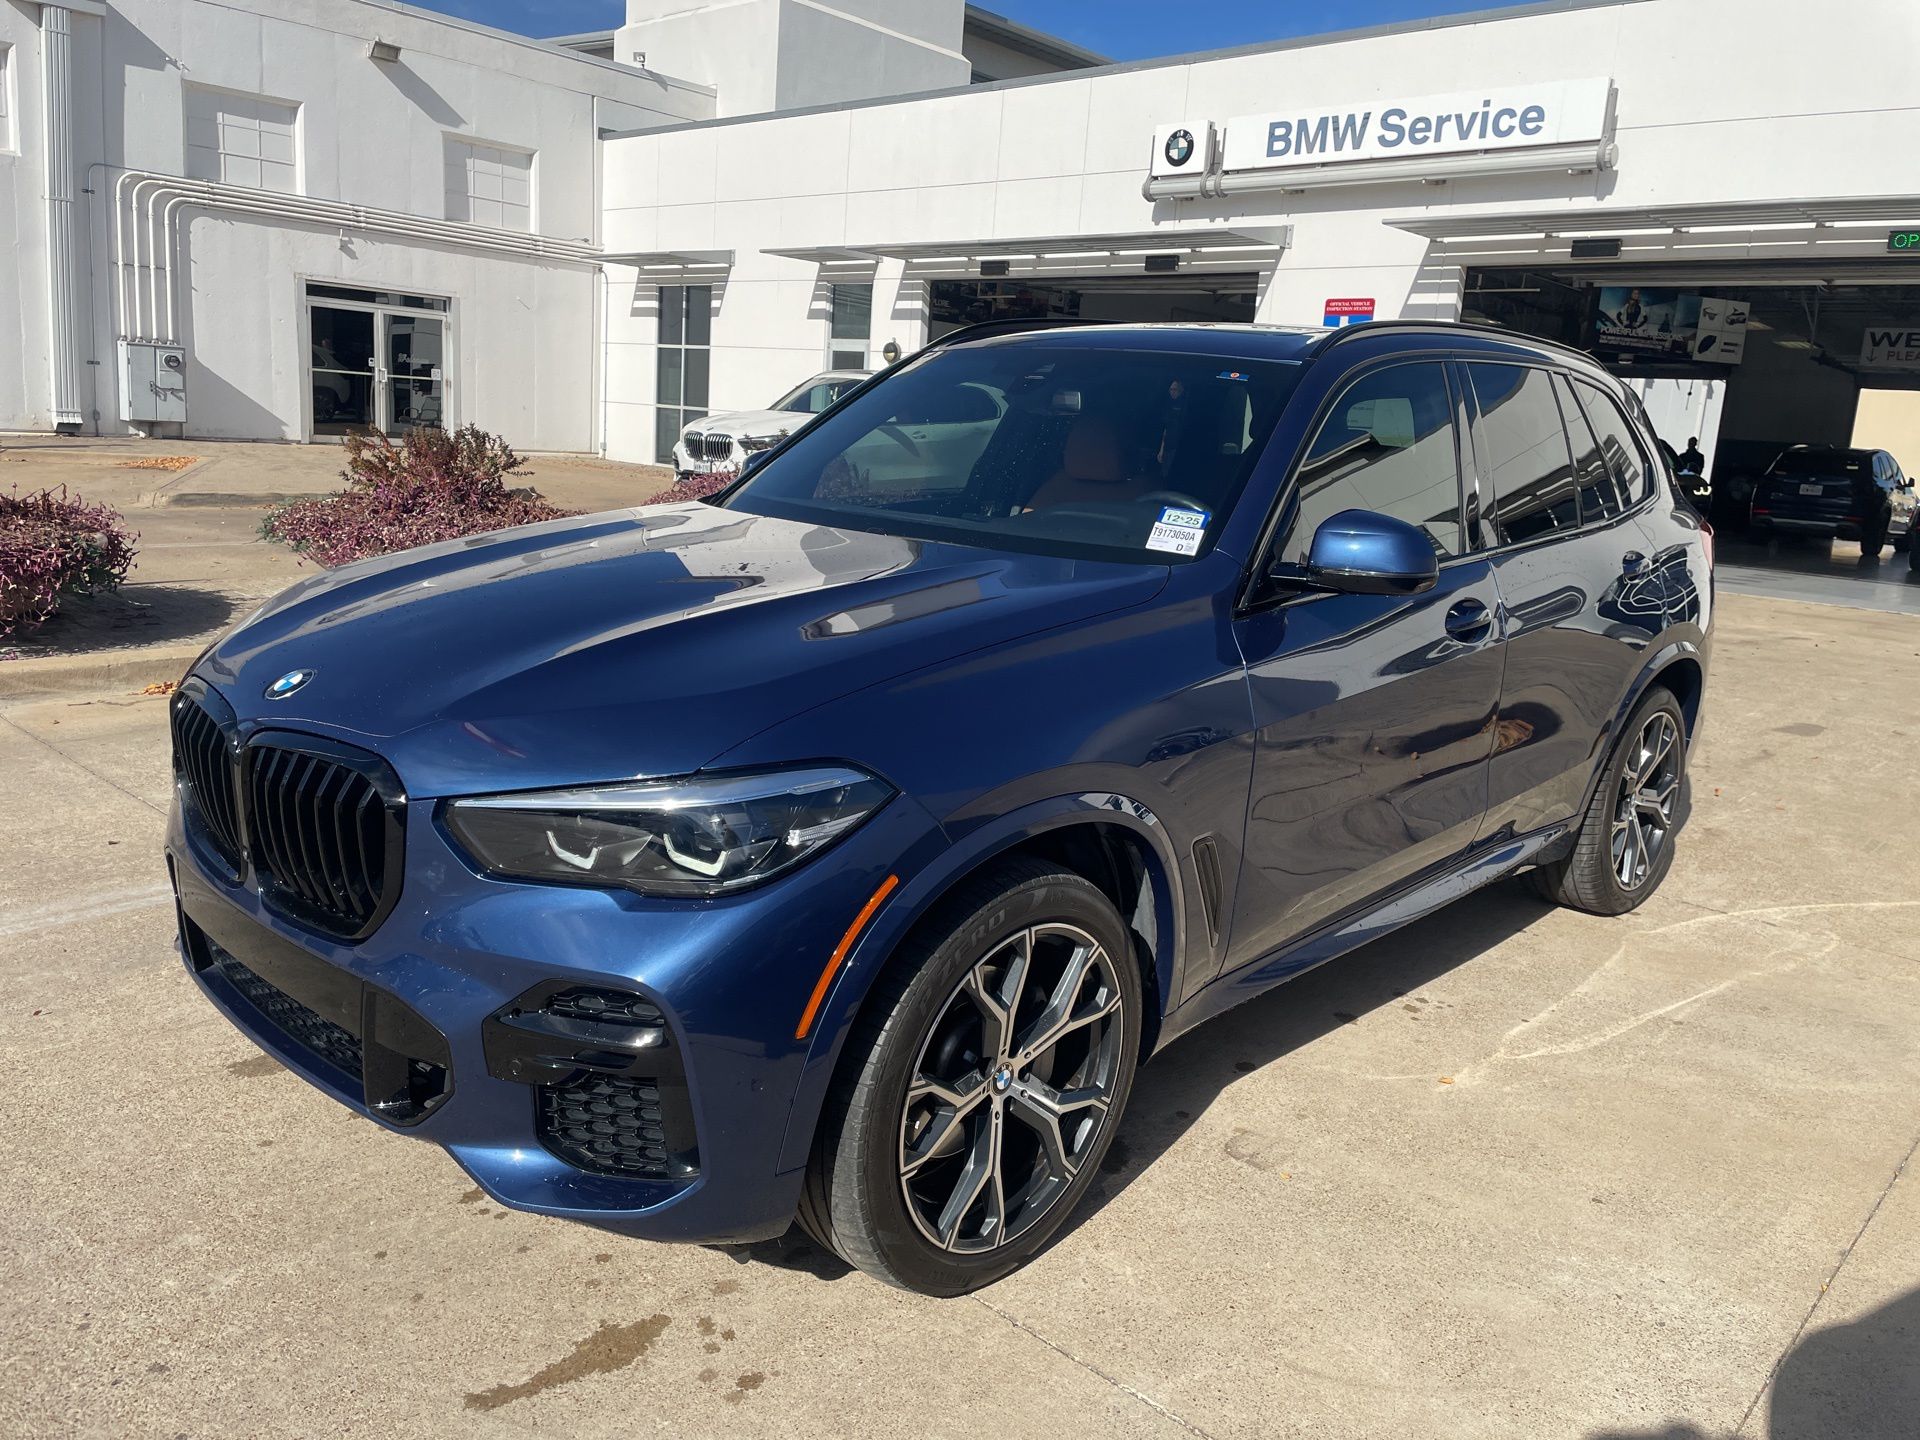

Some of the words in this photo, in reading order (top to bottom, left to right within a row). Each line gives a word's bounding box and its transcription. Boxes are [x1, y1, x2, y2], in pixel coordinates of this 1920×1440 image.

[1266, 112, 1371, 157] BMW
[1377, 99, 1545, 148] Service
[1600, 326, 1638, 337] POWERFUL
[1166, 514, 1180, 522] 12
[1184, 516, 1201, 525] 25
[1153, 527, 1196, 541] T9173050A
